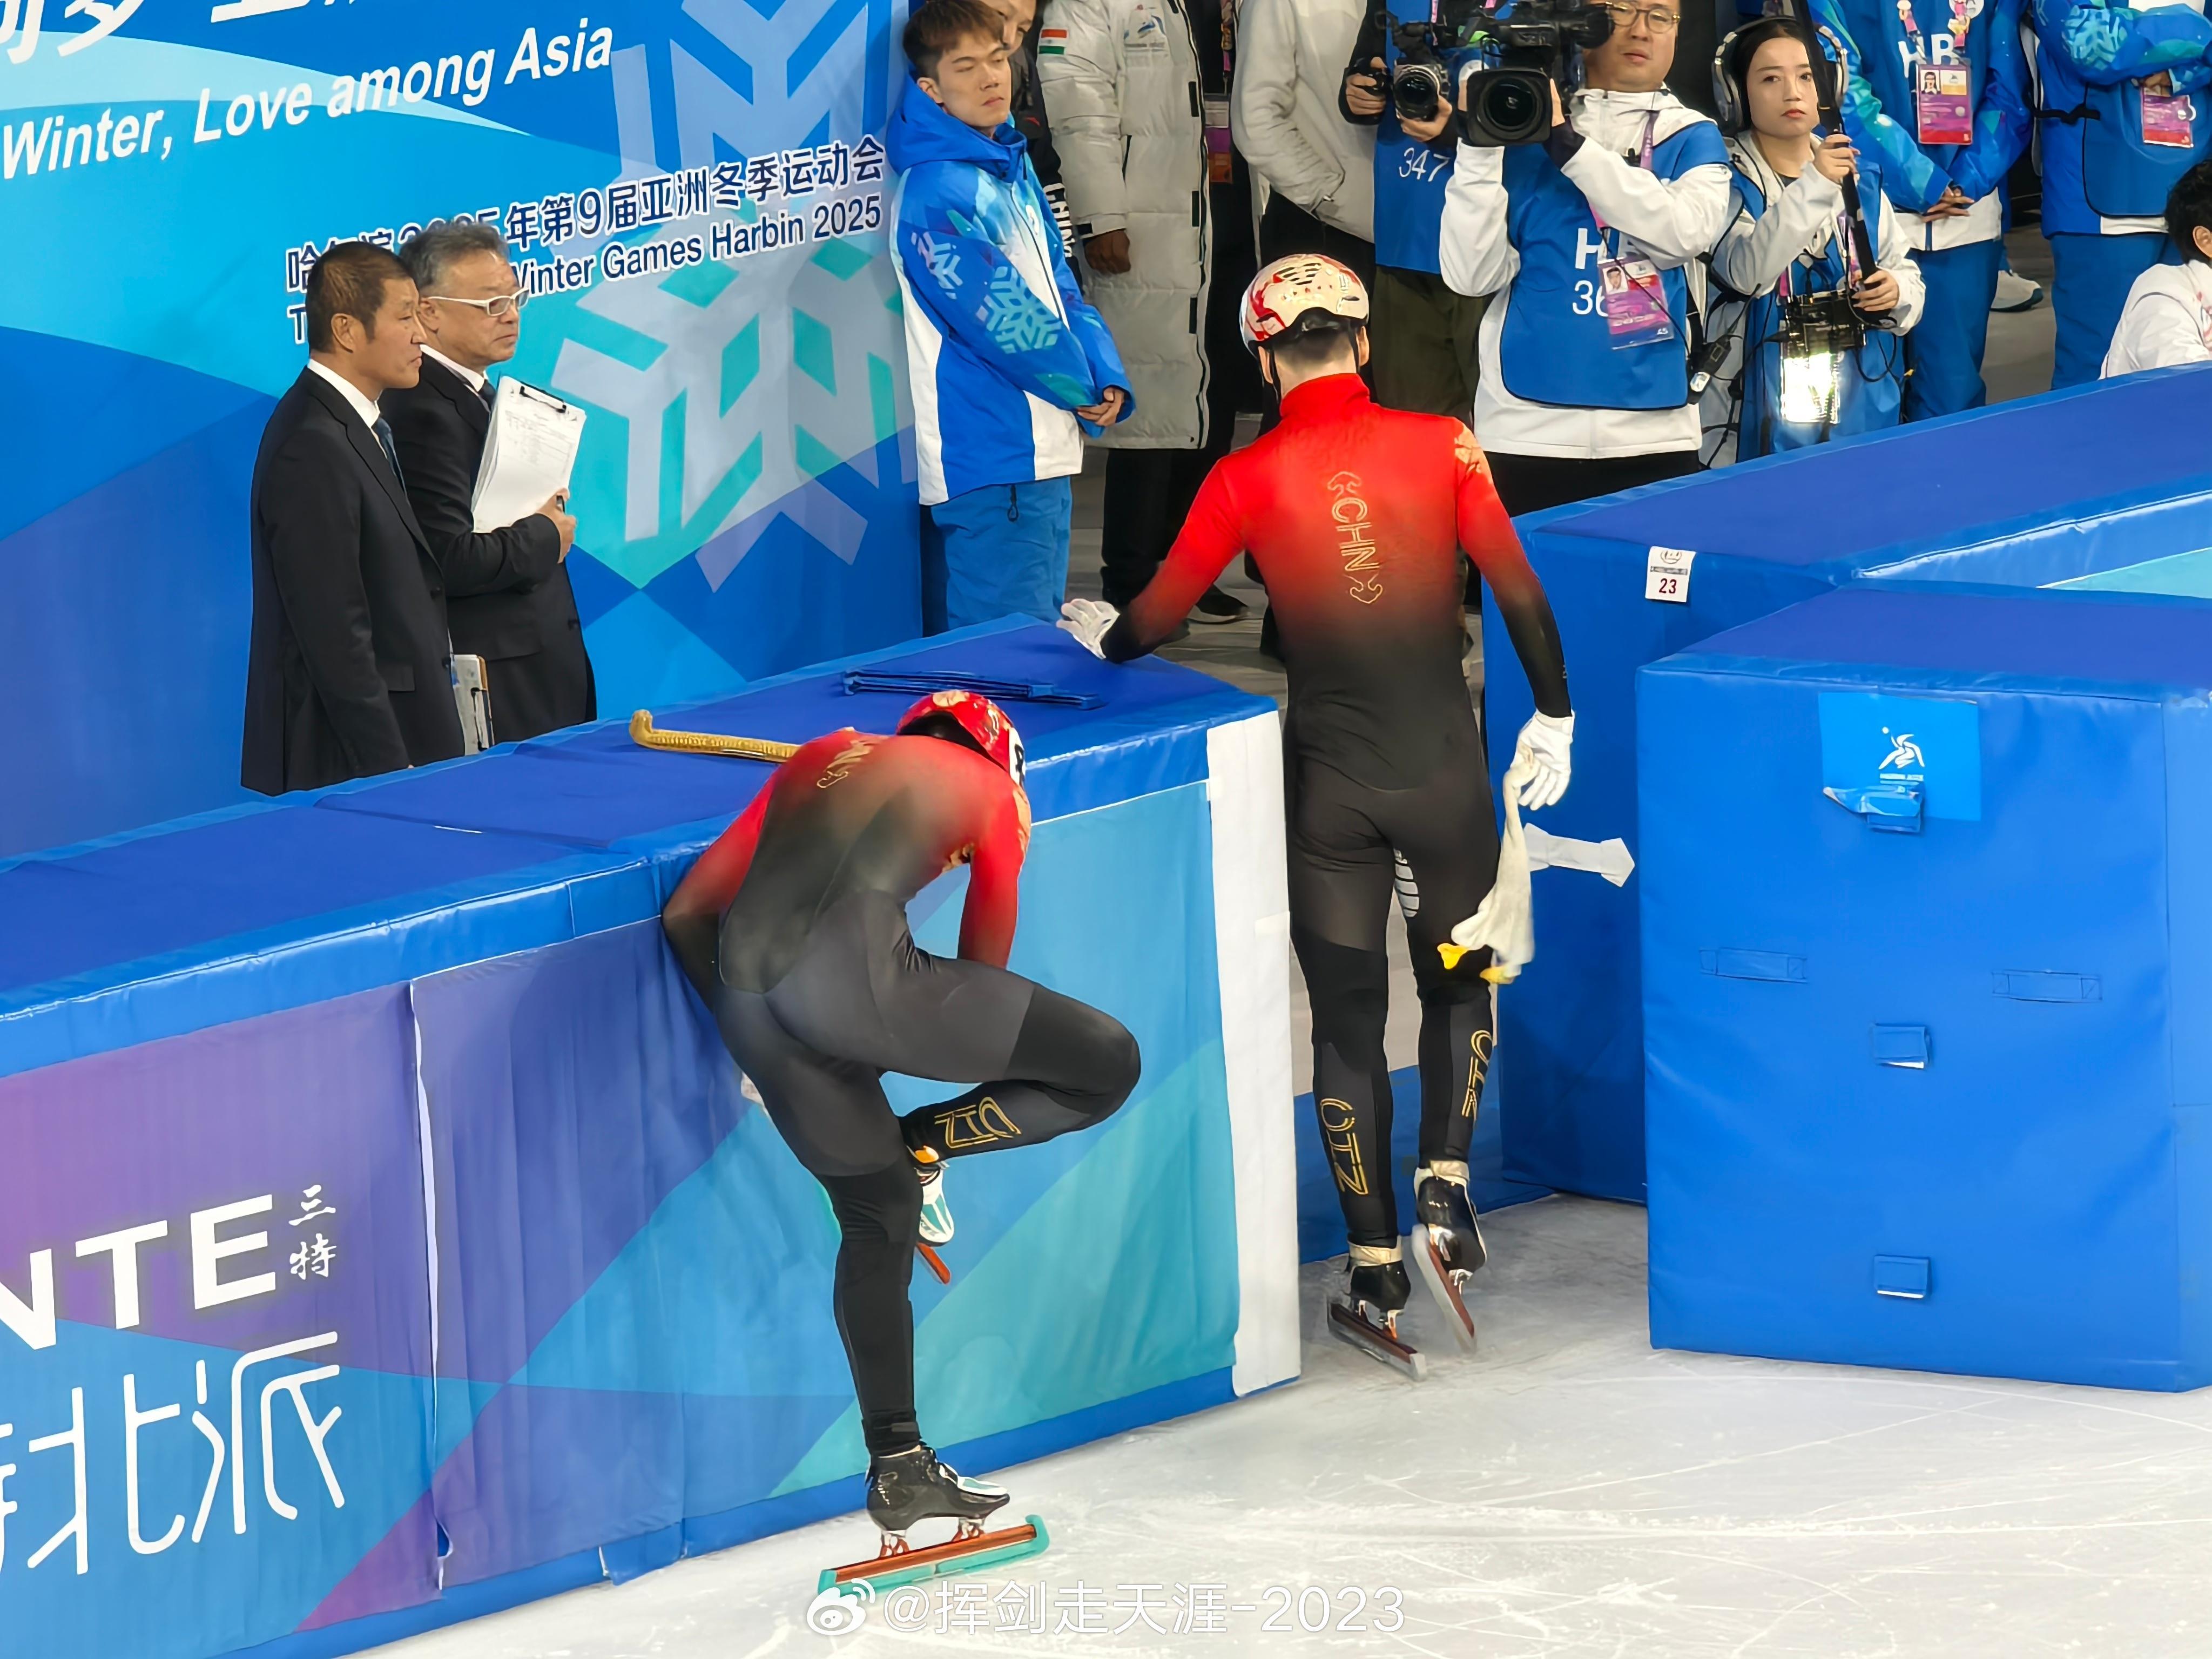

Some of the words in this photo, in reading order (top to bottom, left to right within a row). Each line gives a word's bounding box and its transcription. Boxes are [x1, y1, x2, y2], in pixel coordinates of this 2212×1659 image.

[3, 109, 172, 179] Winter,
[194, 84, 313, 144] Love
[327, 49, 494, 118] among
[505, 17, 612, 85] Asia
[1399, 147, 1451, 182] 347
[287, 136, 885, 291] 哈年第9届亚洲冬季运动会
[603, 234, 702, 279] Games
[712, 215, 803, 257] Harbin
[814, 198, 881, 240] 2025
[1332, 496, 1380, 572] CHN
[1658, 578, 1677, 594] 23
[288, 1184, 337, 1280] 三特
[0, 1331, 345, 1575] 北派
